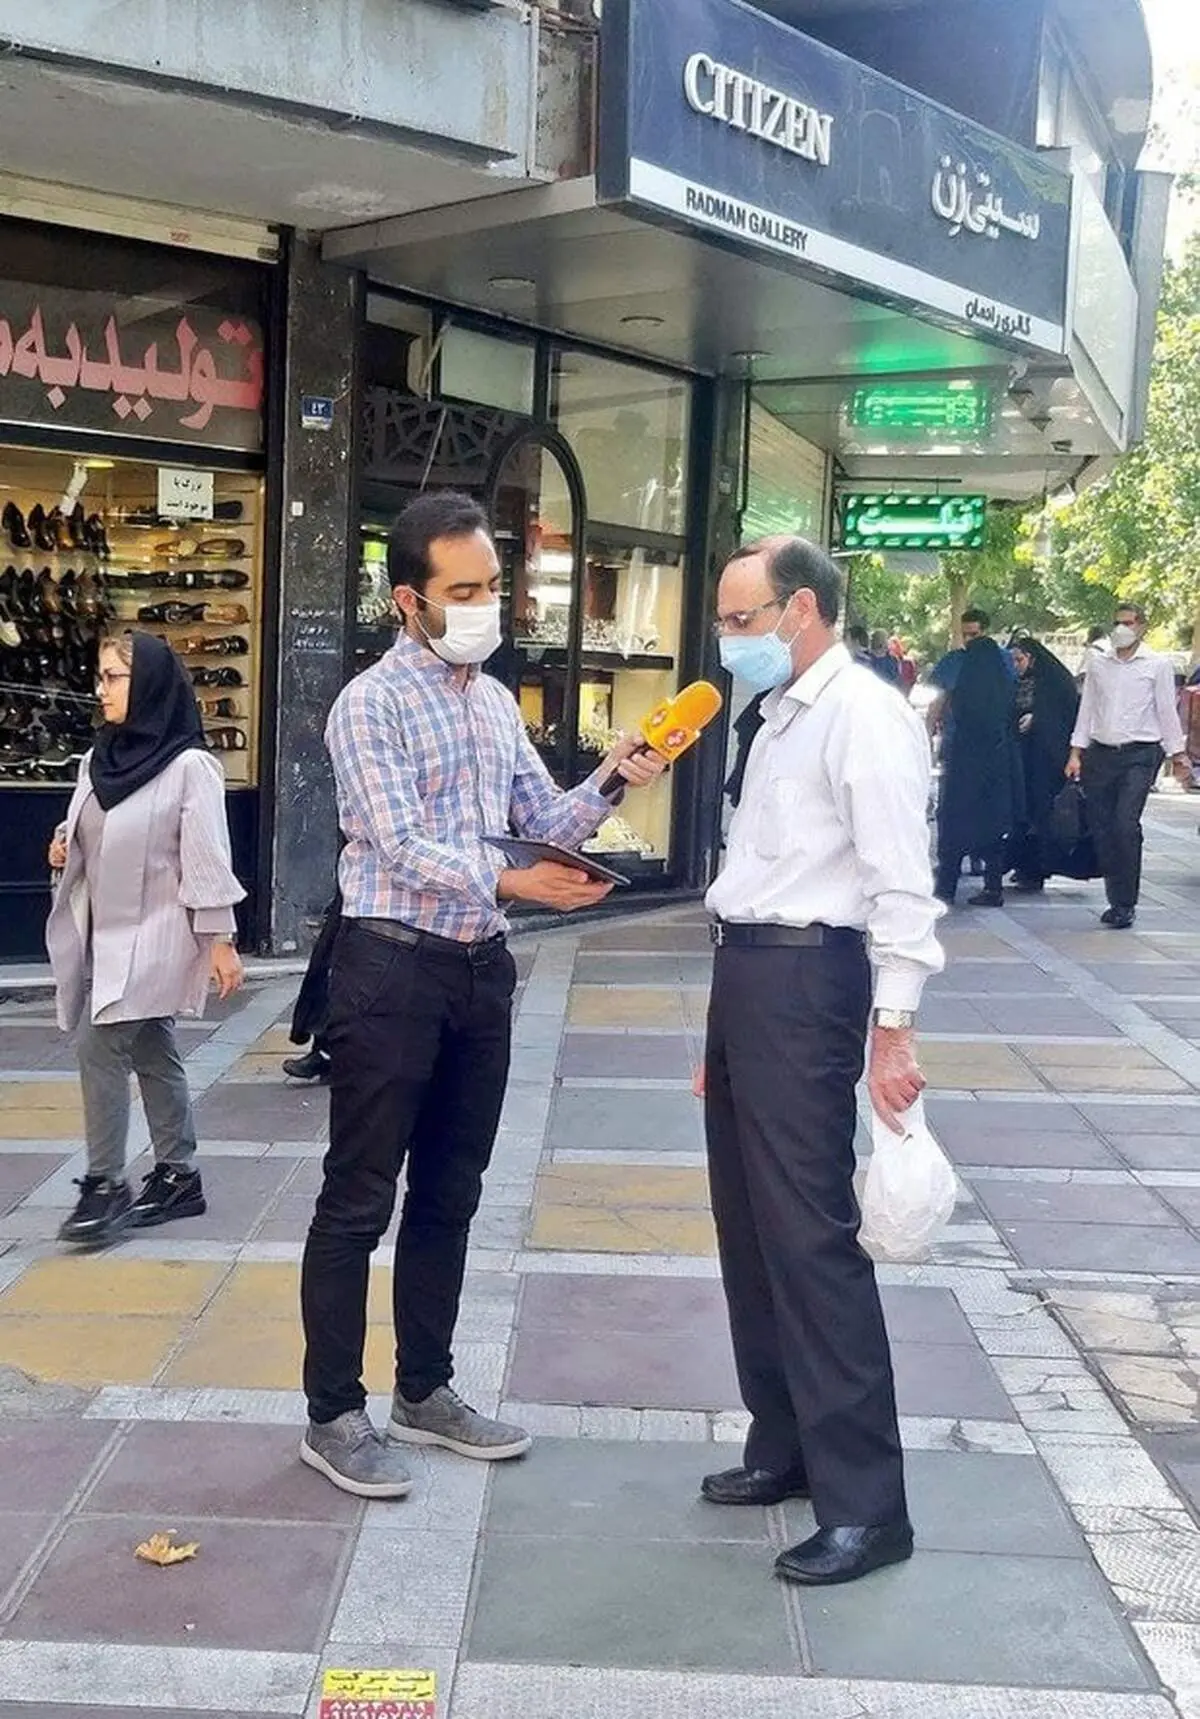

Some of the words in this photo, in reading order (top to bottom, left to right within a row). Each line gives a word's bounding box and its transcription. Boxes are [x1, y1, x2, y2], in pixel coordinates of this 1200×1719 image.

[684, 52, 834, 166] CITIZEN
[686, 187, 746, 229] RADMAN
[749, 212, 808, 251] GALLERY
[12, 304, 81, 410] به
[965, 298, 1001, 329] رادمان
[80, 316, 264, 430] تولید
